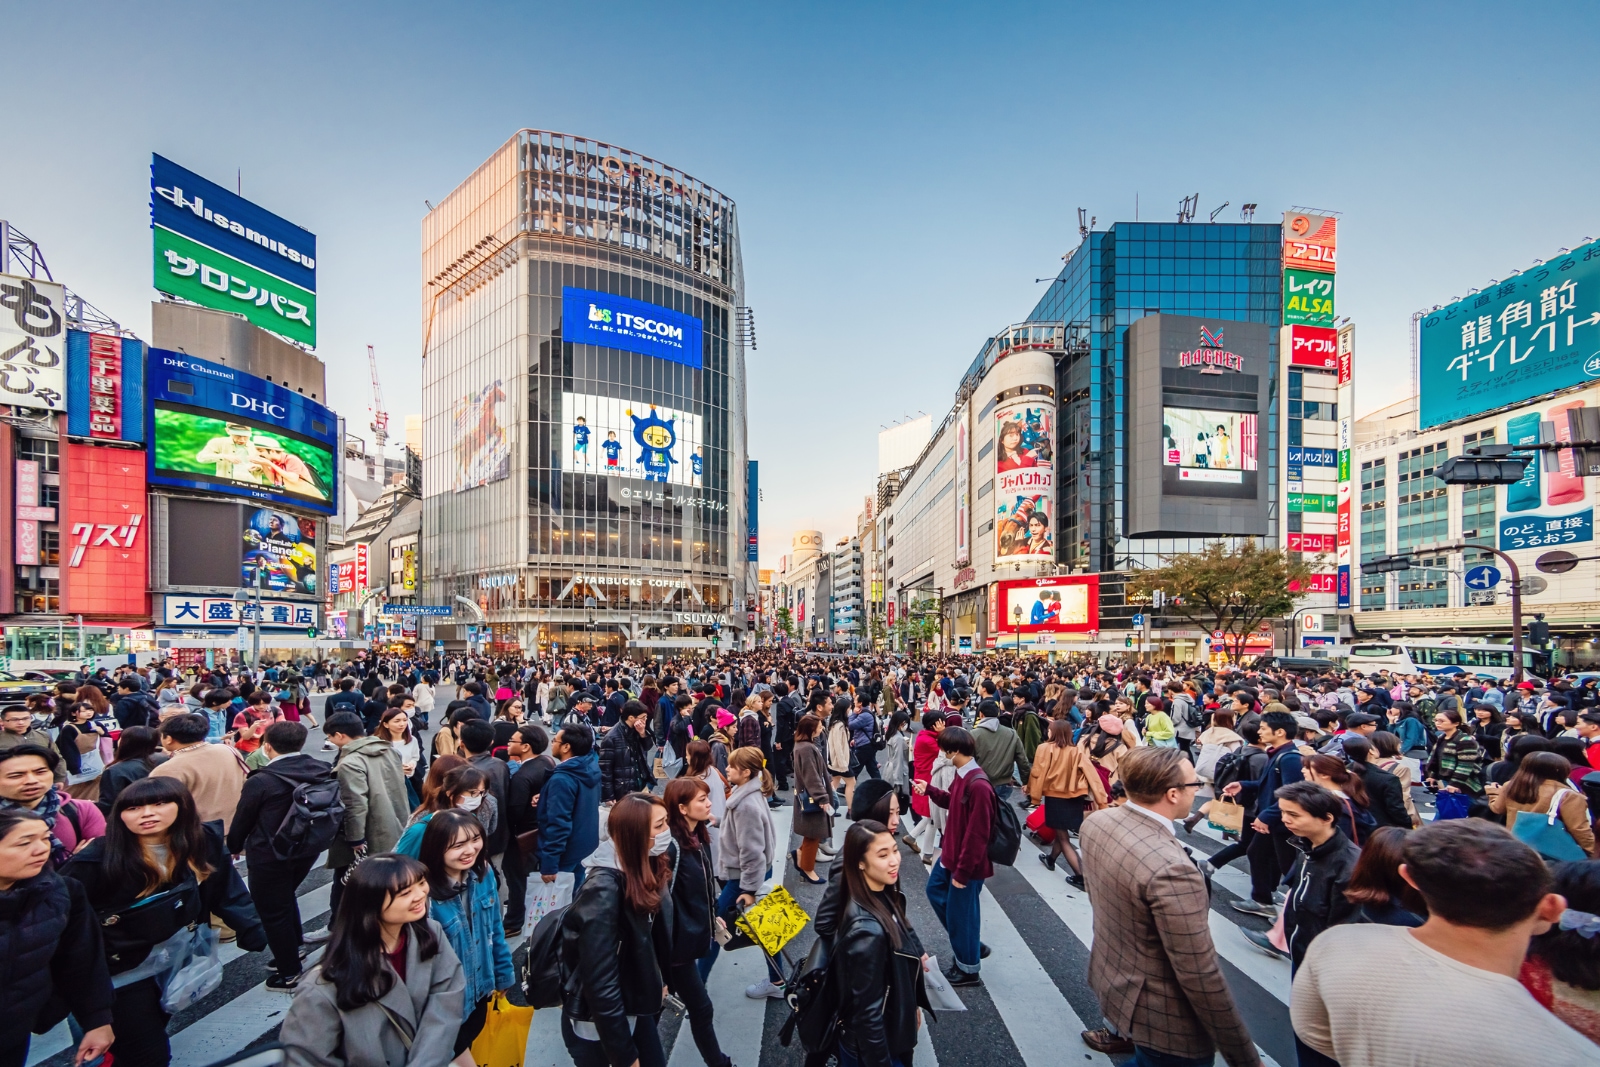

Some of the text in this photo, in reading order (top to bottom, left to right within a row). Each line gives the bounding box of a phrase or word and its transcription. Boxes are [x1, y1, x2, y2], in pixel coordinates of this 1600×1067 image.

[155, 186, 315, 269] Hisamitsu
[1293, 242, 1336, 262] アコム
[164, 249, 311, 327] サロンパス
[1289, 276, 1332, 296] レイク
[1287, 296, 1333, 314] ALSA
[1461, 279, 1578, 350] 龍角散
[1294, 337, 1336, 353] アイフル
[1446, 312, 1600, 381] ダイレクト
[163, 357, 235, 380] DHC Channel
[1180, 349, 1244, 371] MAGNET
[1324, 359, 1336, 367] 8F
[90, 336, 115, 433] 三千里薬品
[231, 392, 285, 419] DHC
[1289, 452, 1333, 464] レオパレス21
[1001, 472, 1052, 489] ジャパンカップ
[1503, 517, 1591, 536] のど、直接、
[69, 514, 143, 568] クスリ
[1291, 537, 1321, 548] アコム
[1512, 531, 1577, 548] うるおう
[260, 541, 303, 558] Planets
[575, 576, 686, 589] STARBUCKS COFFEE
[175, 601, 313, 623] 大盛堂書店
[675, 613, 727, 625] TSUTAYA
[1305, 615, 1319, 629] 0円
